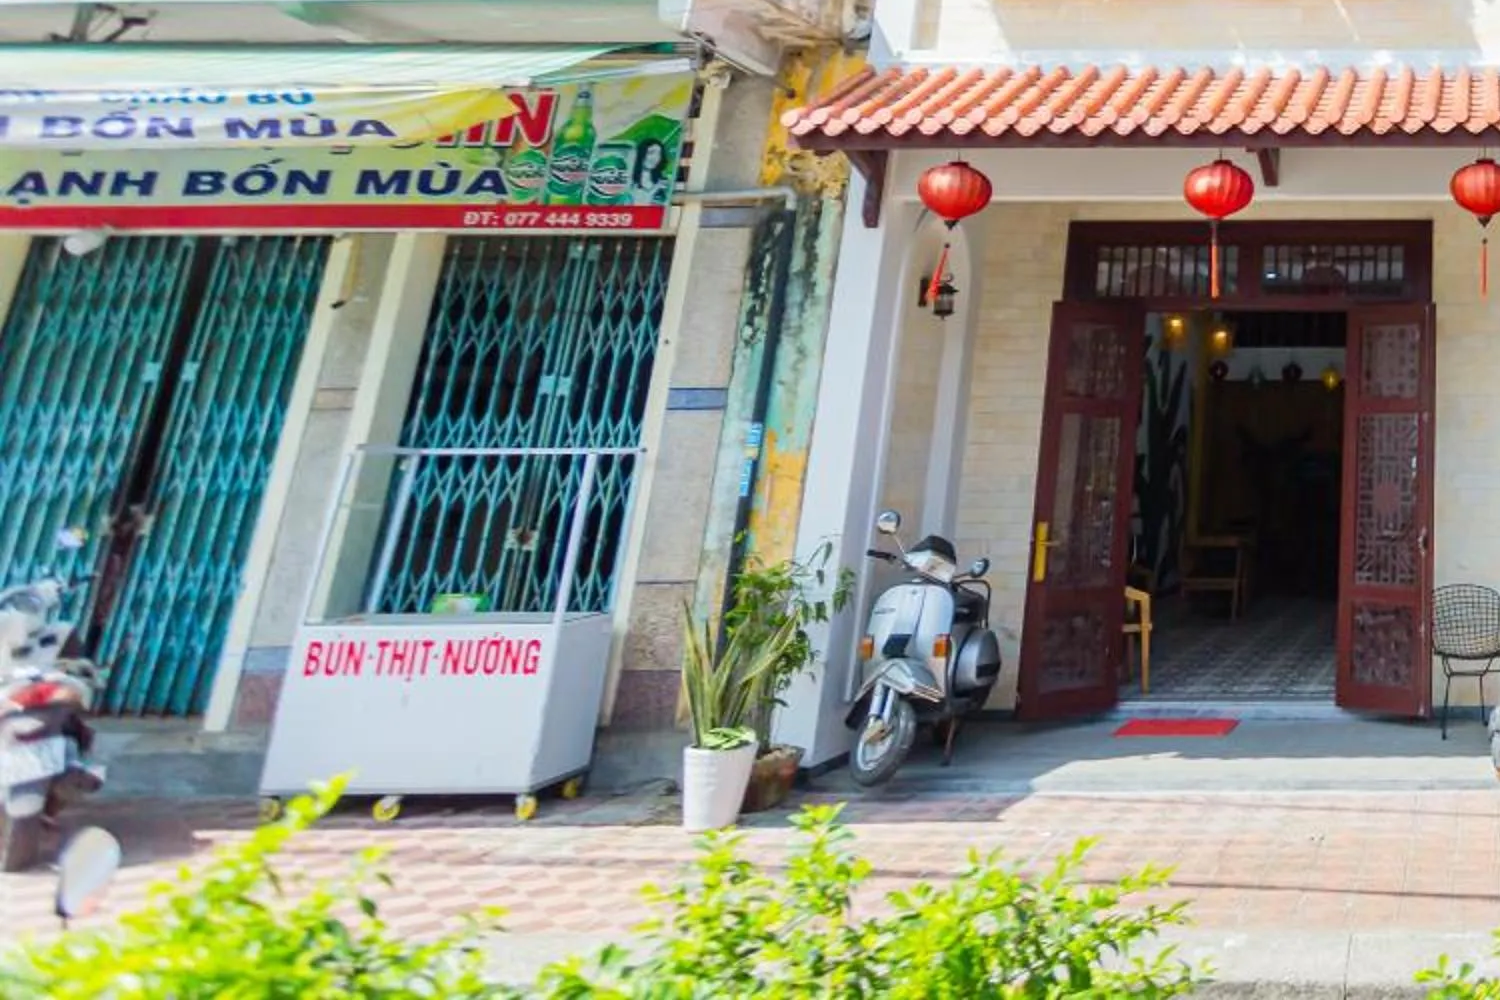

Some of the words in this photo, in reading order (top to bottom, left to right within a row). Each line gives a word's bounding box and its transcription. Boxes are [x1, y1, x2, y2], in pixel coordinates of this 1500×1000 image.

[224, 112, 398, 140] MÙA
[182, 157, 334, 197] BỐN
[354, 161, 509, 196] MÙA
[463, 211, 500, 226] ĐT:
[503, 211, 539, 226] 077
[544, 211, 580, 226] 444
[585, 211, 633, 227] 9339
[375, 639, 436, 682] THỊT
[440, 631, 543, 676] NƯỚNG
